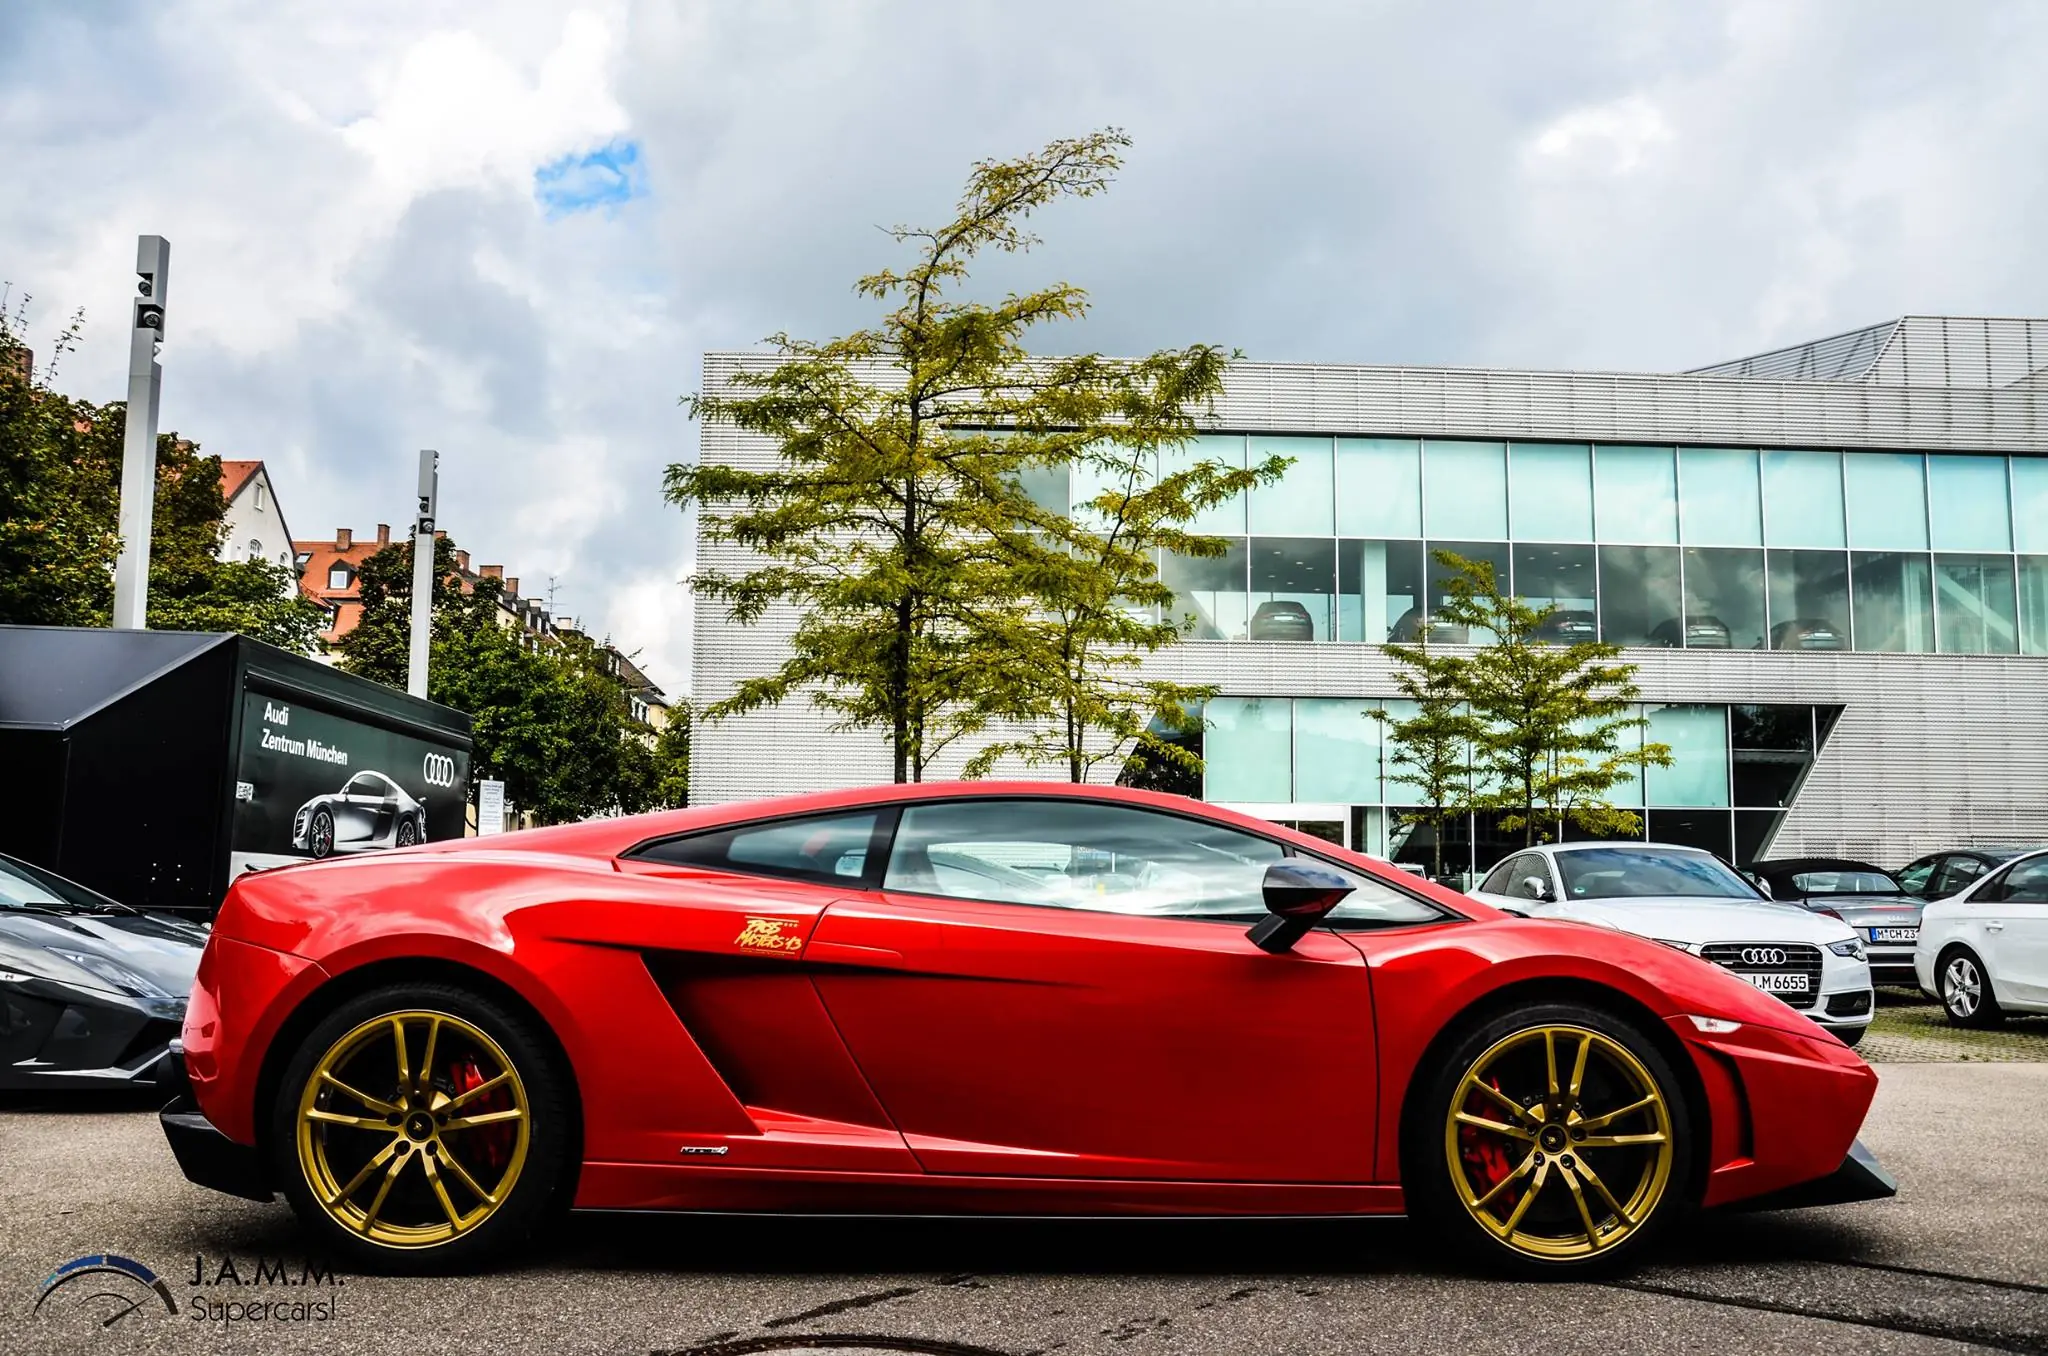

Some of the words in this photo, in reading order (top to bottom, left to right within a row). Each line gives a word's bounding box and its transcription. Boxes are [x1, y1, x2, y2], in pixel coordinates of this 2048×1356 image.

[264, 702, 289, 725] Audi
[261, 728, 305, 755] Zentrum
[306, 739, 348, 766] München
[1774, 975, 1807, 990] 6655
